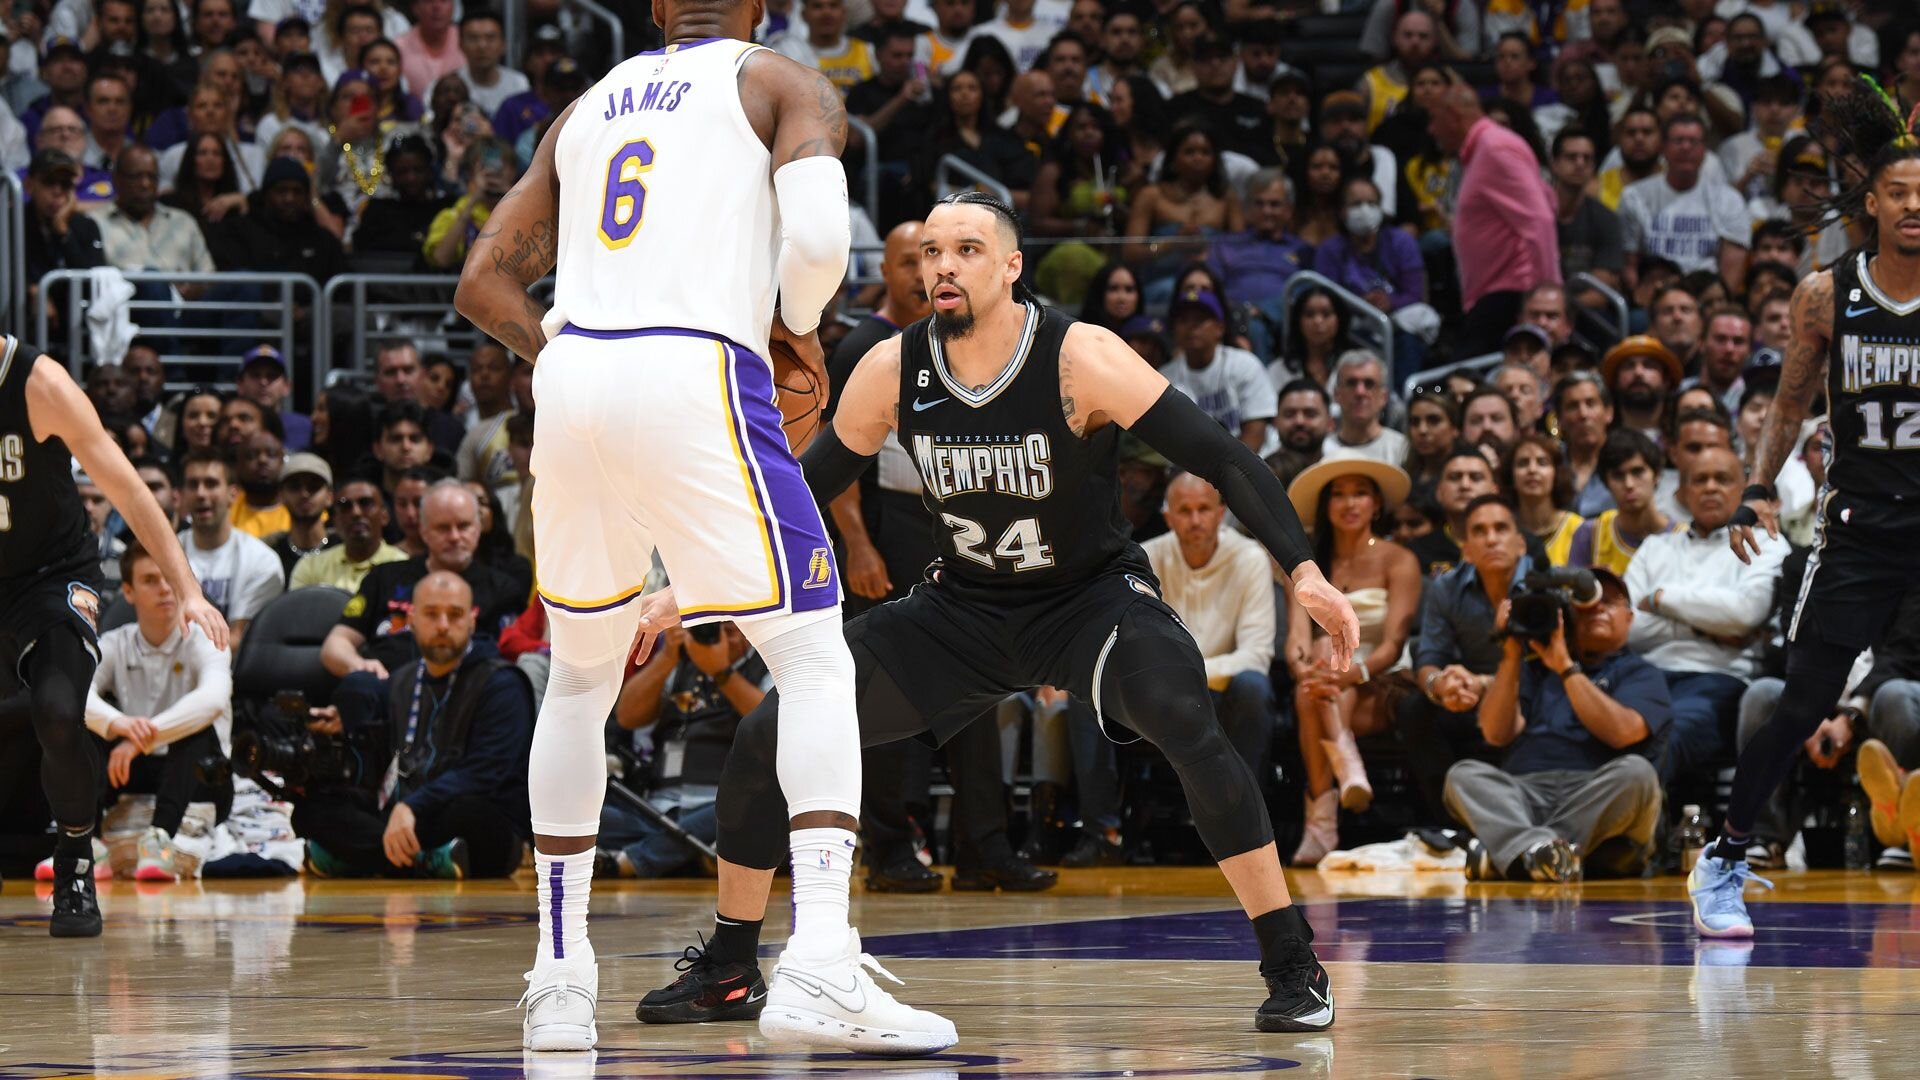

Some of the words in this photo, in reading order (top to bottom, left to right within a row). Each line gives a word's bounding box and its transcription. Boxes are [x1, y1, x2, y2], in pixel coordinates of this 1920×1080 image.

[604, 80, 691, 121] JAMES
[597, 137, 656, 251] 6
[1849, 288, 1862, 302] 6
[917, 369, 930, 388] 6
[1857, 401, 1920, 448] 12
[912, 431, 1054, 502] MEMPHIS
[940, 512, 1055, 572] 24
